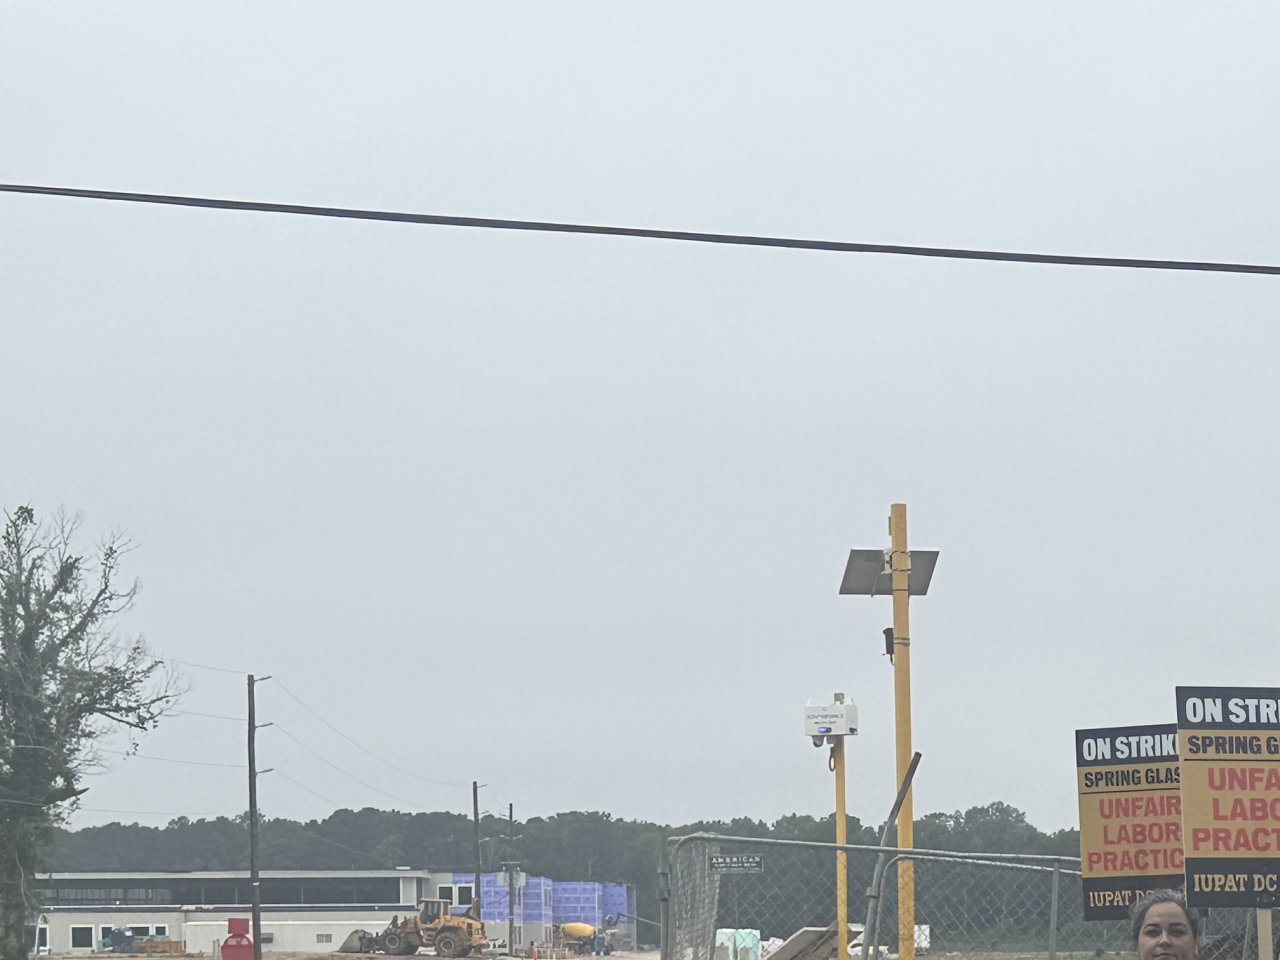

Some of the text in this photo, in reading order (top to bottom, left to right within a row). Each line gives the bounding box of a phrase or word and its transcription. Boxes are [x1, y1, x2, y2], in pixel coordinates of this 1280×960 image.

[1185, 698, 1223, 723] ON
[1083, 734, 1179, 761] ON STRIK
[1187, 735, 1262, 754] SPRING
[1084, 766, 1180, 788] SPRING GLAS
[1099, 795, 1181, 819] UNFAIR
[1103, 822, 1180, 845] LABOR
[1087, 848, 1184, 872] PRACTIC
[1193, 874, 1247, 892] IUPAT
[1253, 873, 1277, 892] DC
[1089, 890, 1131, 907] IUPAT
